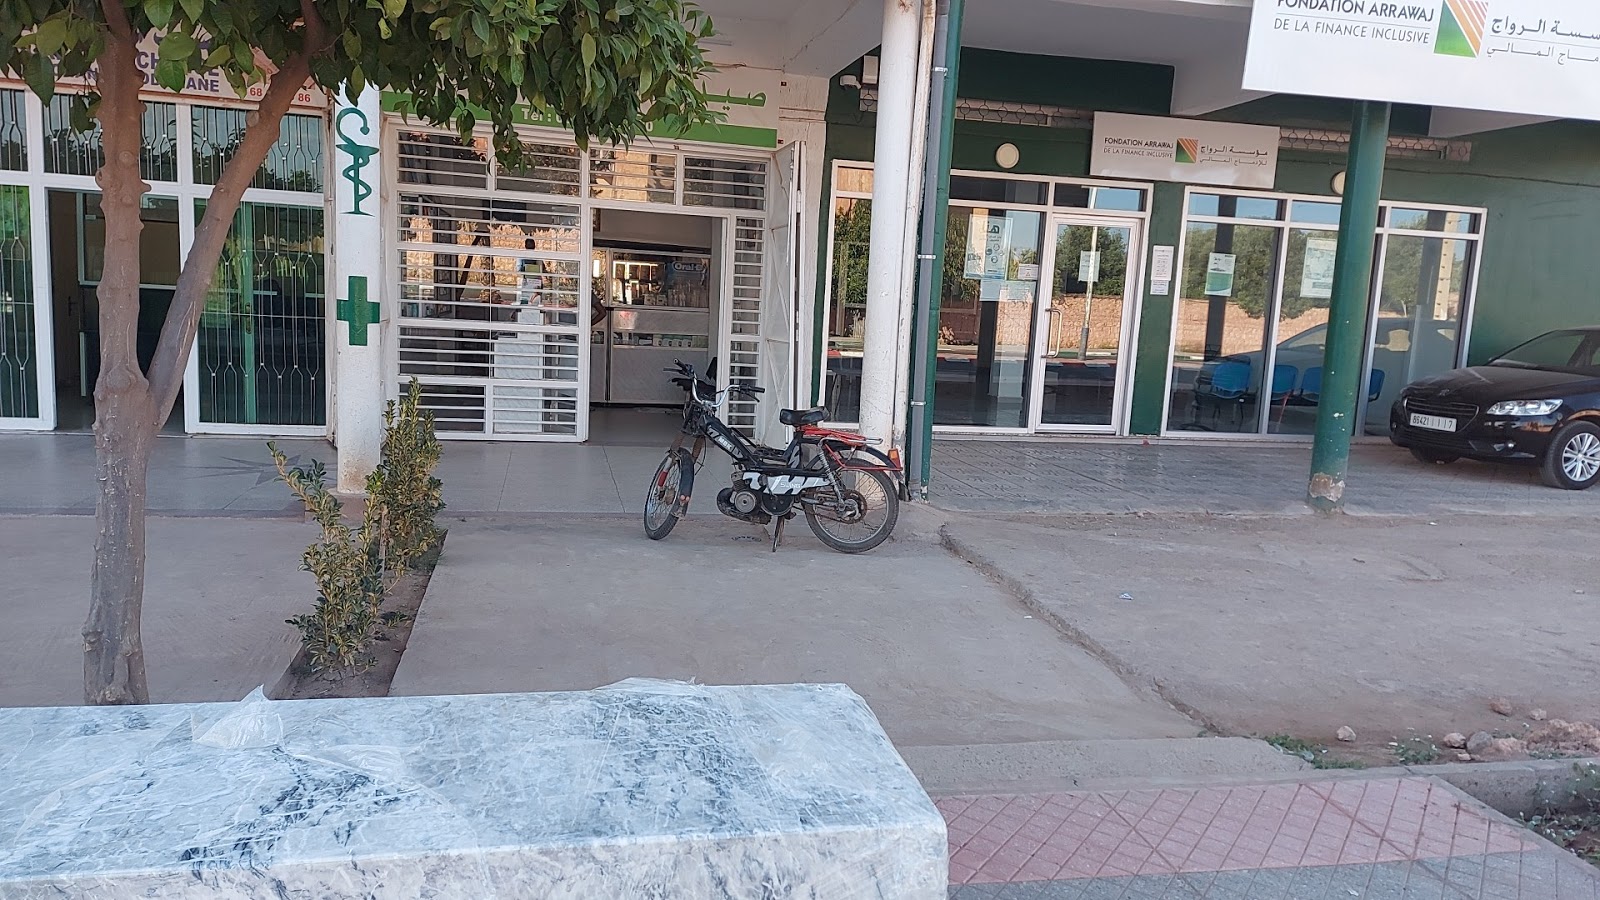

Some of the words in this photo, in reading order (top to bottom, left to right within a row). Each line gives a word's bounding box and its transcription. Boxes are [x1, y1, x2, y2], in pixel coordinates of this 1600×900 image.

[1368, 2, 1435, 22] ARRAWAJ
[1274, 18, 1290, 30] DE
[1294, 21, 1310, 32] LA
[1315, 22, 1367, 38] FINANCE
[1371, 27, 1430, 44] INCLUSIVE
[1491, 16, 1546, 35] الرواج
[1486, 42, 1554, 57] المالي
[1104, 137, 1143, 146] FONDATION
[1144, 140, 1174, 149] ARRAWAJ
[1200, 145, 1228, 154] الرواج
[1146, 151, 1173, 159] INCLUSIVE
